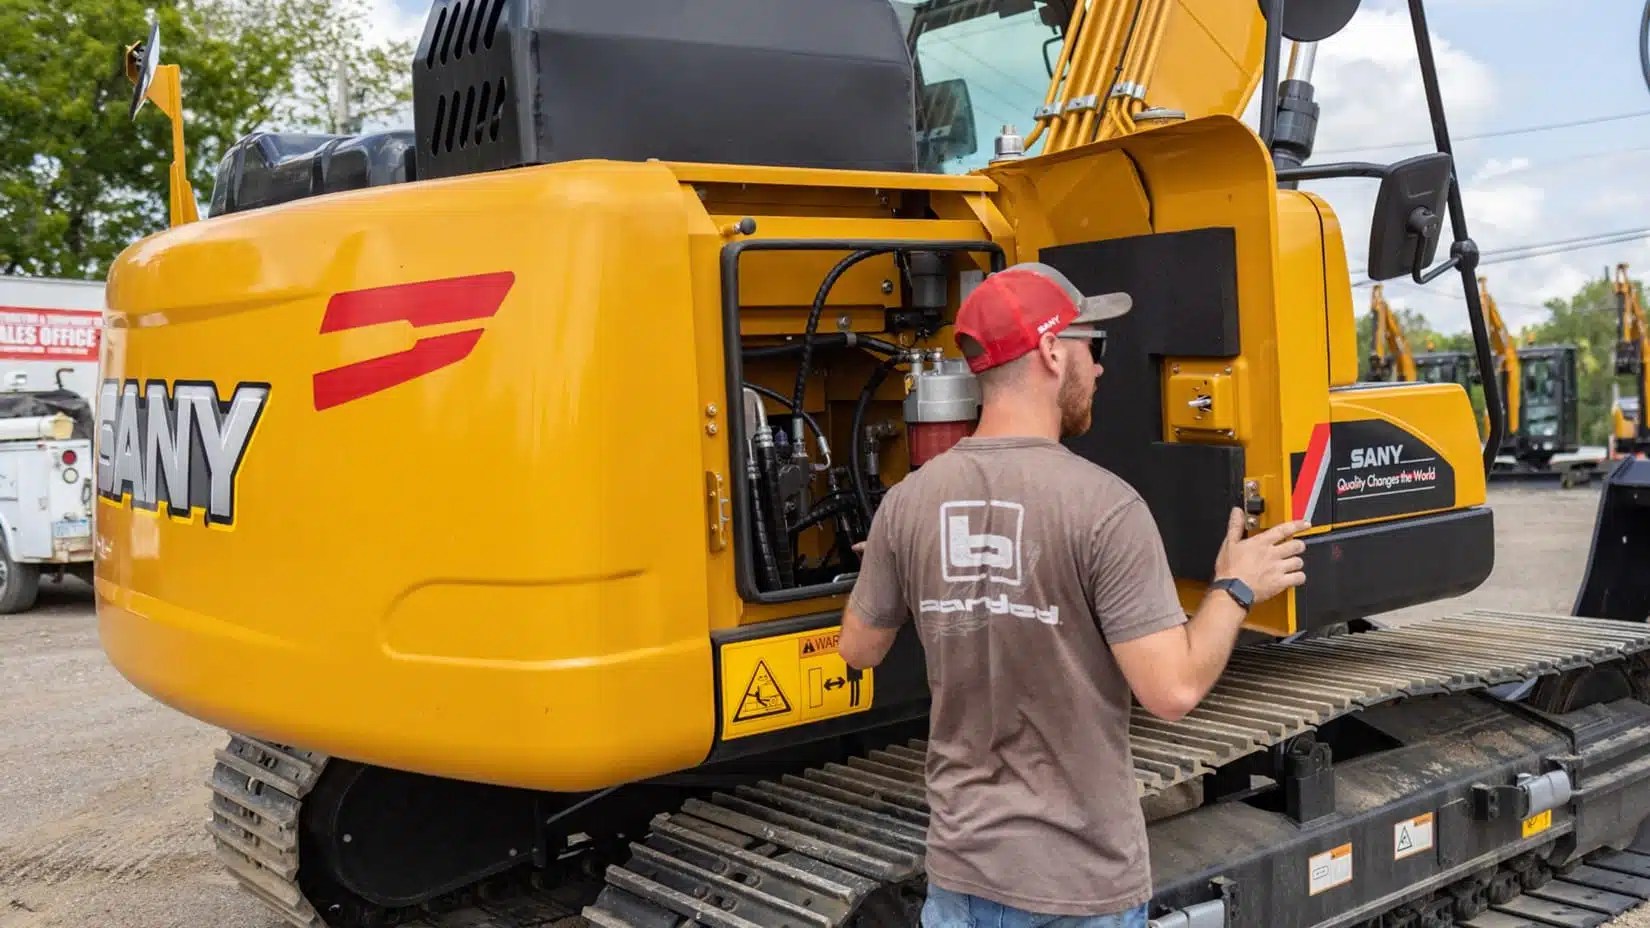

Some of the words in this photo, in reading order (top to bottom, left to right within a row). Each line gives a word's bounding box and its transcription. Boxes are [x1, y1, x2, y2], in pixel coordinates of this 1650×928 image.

[40, 326, 97, 349] OFFICE
[98, 379, 272, 528] SANY
[1350, 444, 1404, 469] SANY
[1337, 475, 1366, 493] Quality
[1367, 472, 1400, 488] Changes
[1400, 470, 1412, 483] the
[1413, 465, 1436, 481] World
